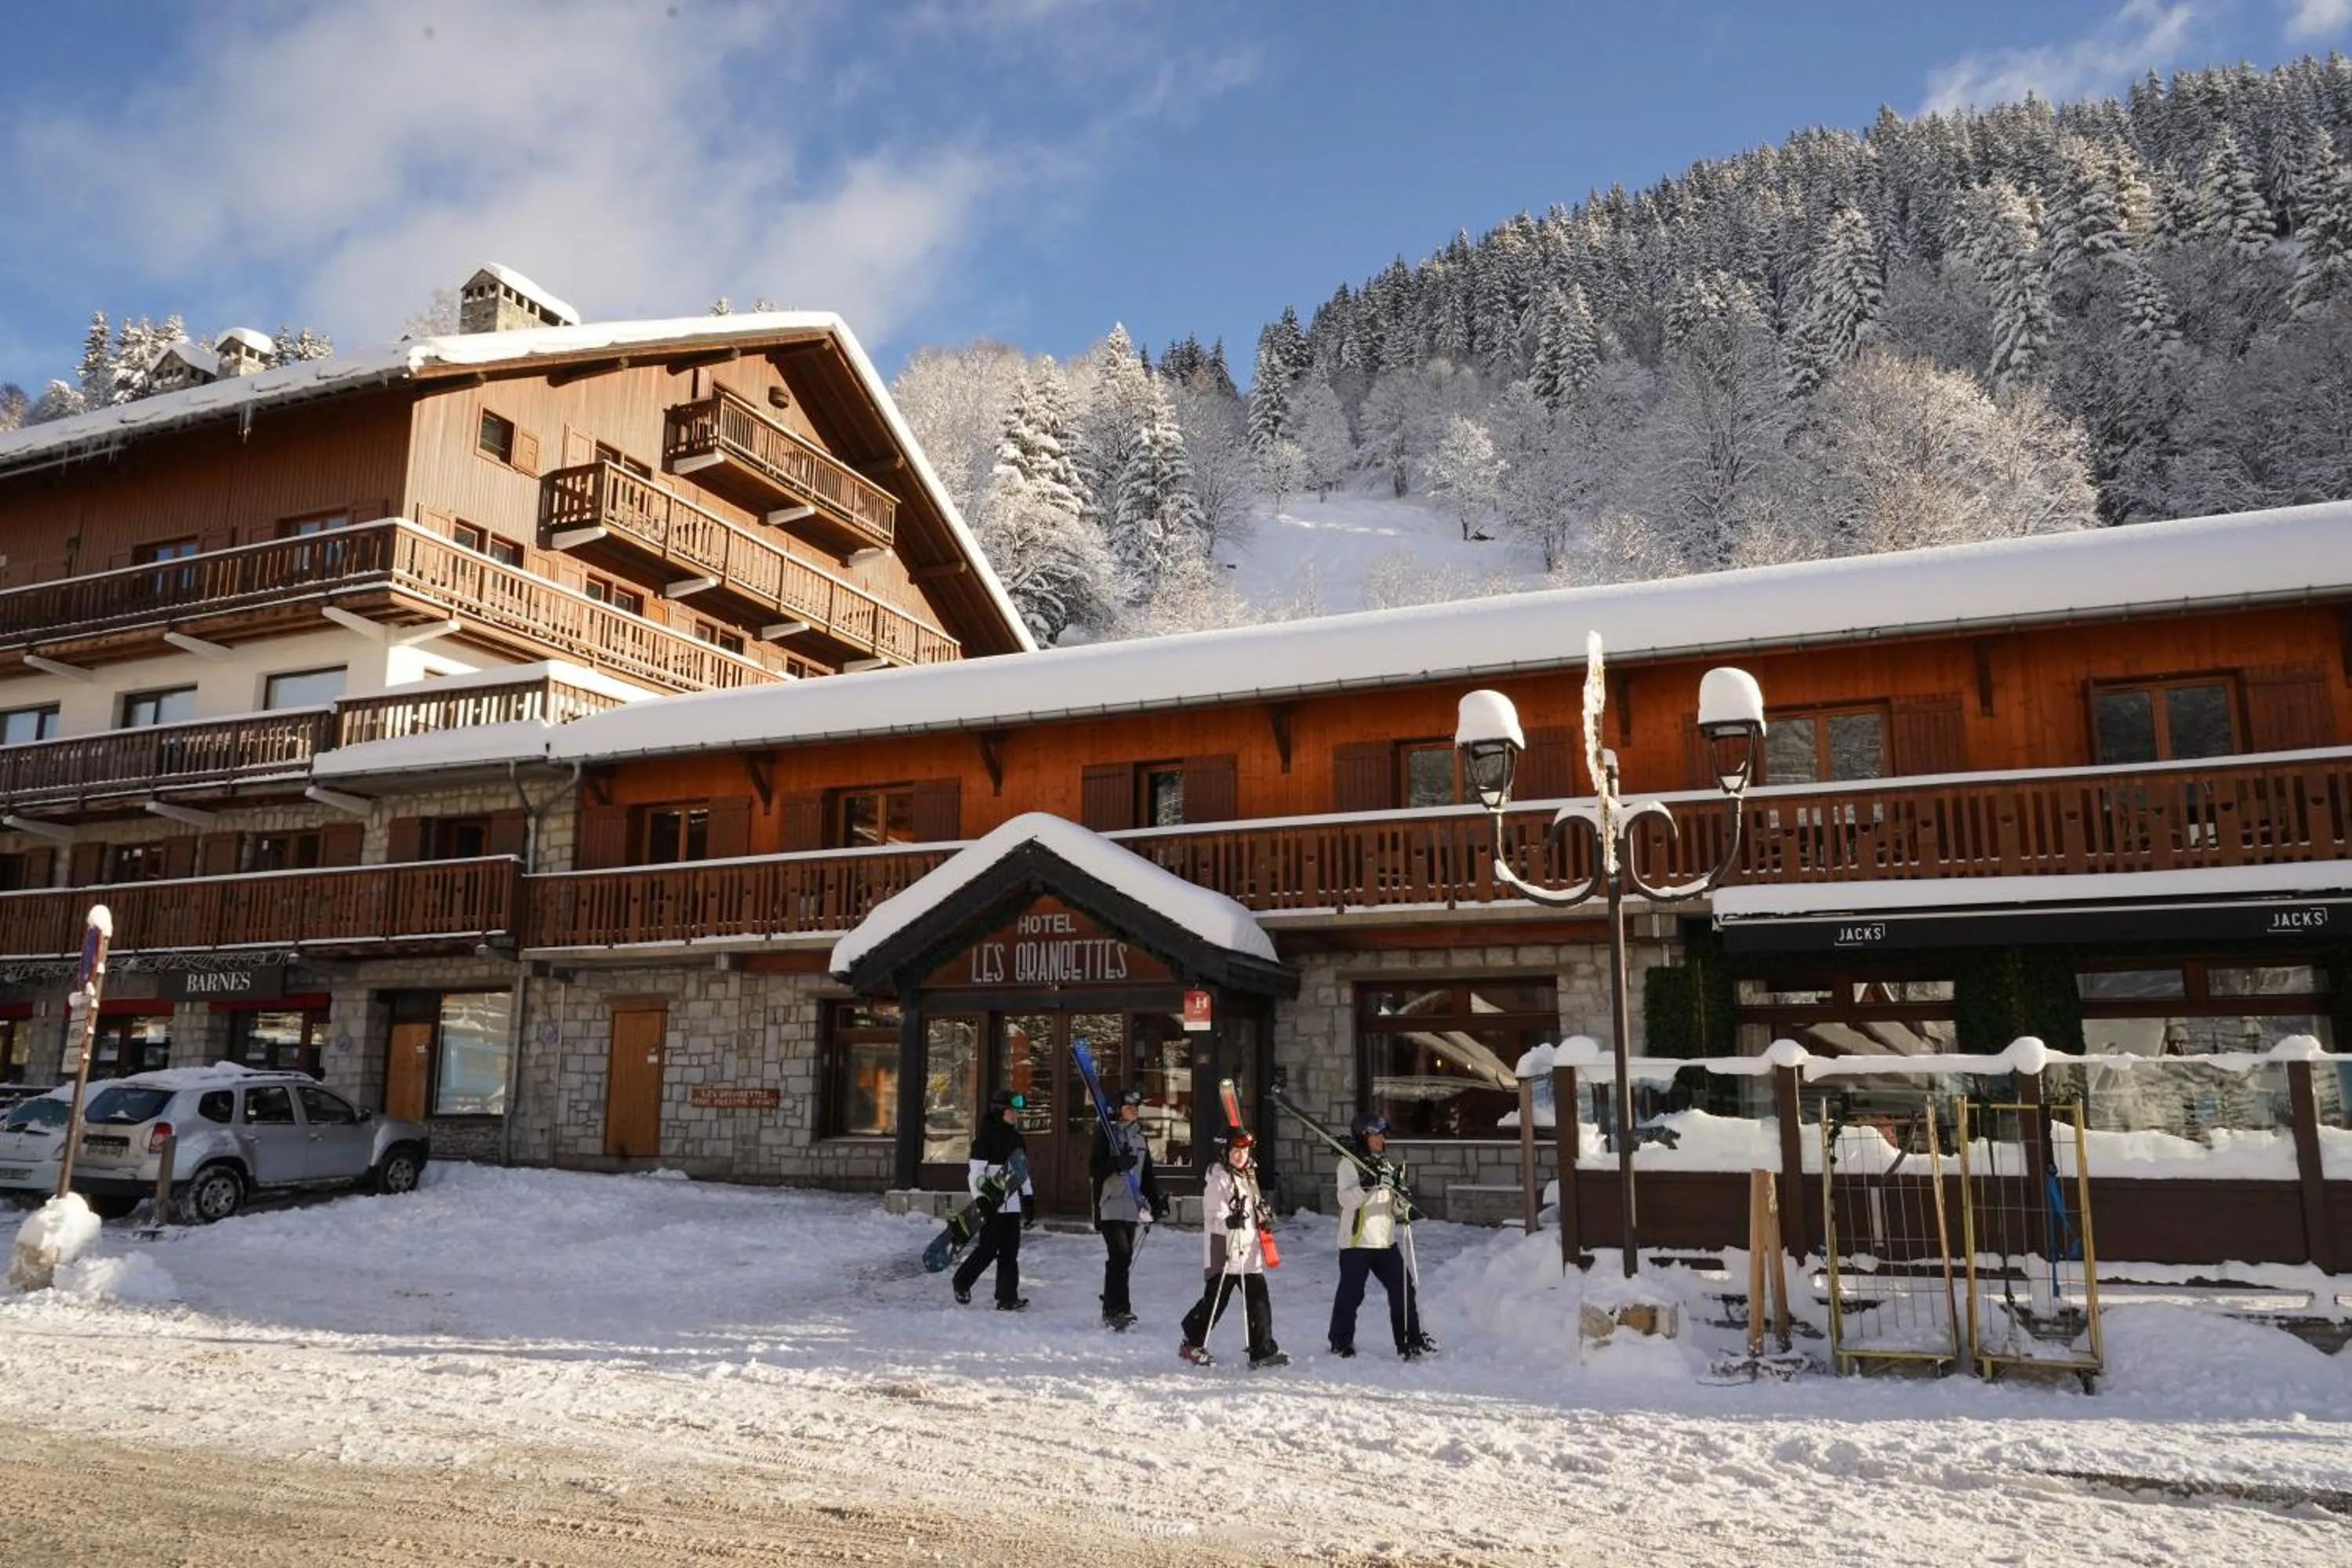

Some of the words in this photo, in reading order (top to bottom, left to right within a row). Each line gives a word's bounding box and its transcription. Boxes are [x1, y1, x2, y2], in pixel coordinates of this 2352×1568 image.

[1018, 913, 1076, 934] HOTEL
[2272, 912, 2324, 927] JACKS
[1838, 927, 1882, 942] JACKS
[971, 943, 1005, 982] LES
[1015, 938, 1127, 981] GRANGETTES
[186, 972, 251, 992] BARNES
